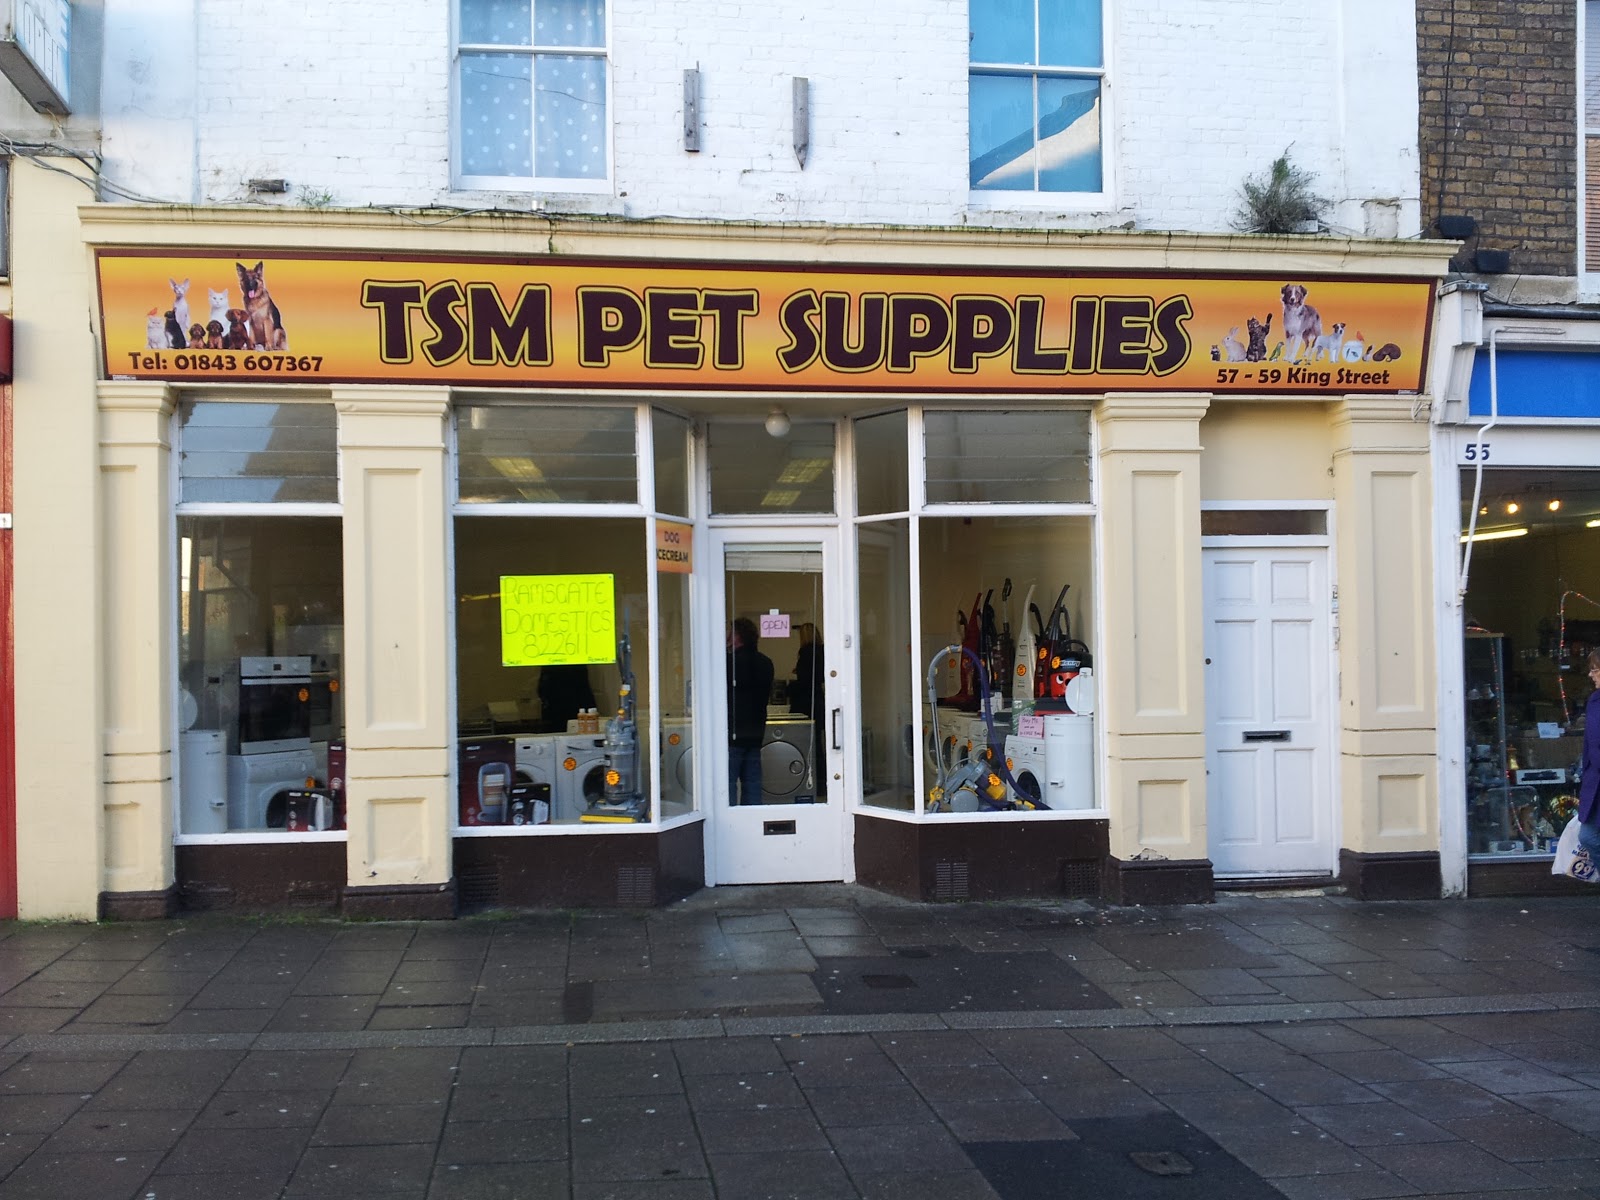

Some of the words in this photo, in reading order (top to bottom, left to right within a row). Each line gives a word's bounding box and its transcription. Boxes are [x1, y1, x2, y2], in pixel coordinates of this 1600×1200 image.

[360, 279, 553, 367] TSM
[576, 285, 759, 370] PET
[776, 288, 1194, 377] SUPPLIES
[128, 352, 167, 370] Tel:
[174, 354, 236, 370] 01843
[243, 355, 323, 372] 607367
[1216, 368, 1239, 384] 57
[1257, 368, 1282, 384] 59
[1287, 367, 1331, 387] King
[1337, 367, 1390, 385] Street
[1465, 443, 1490, 461] 55
[664, 530, 680, 544] DOG
[504, 577, 605, 605] RAMSGATE
[504, 608, 612, 634] DOMESTICS
[762, 620, 788, 635] OPEN
[523, 632, 588, 658] 822611
